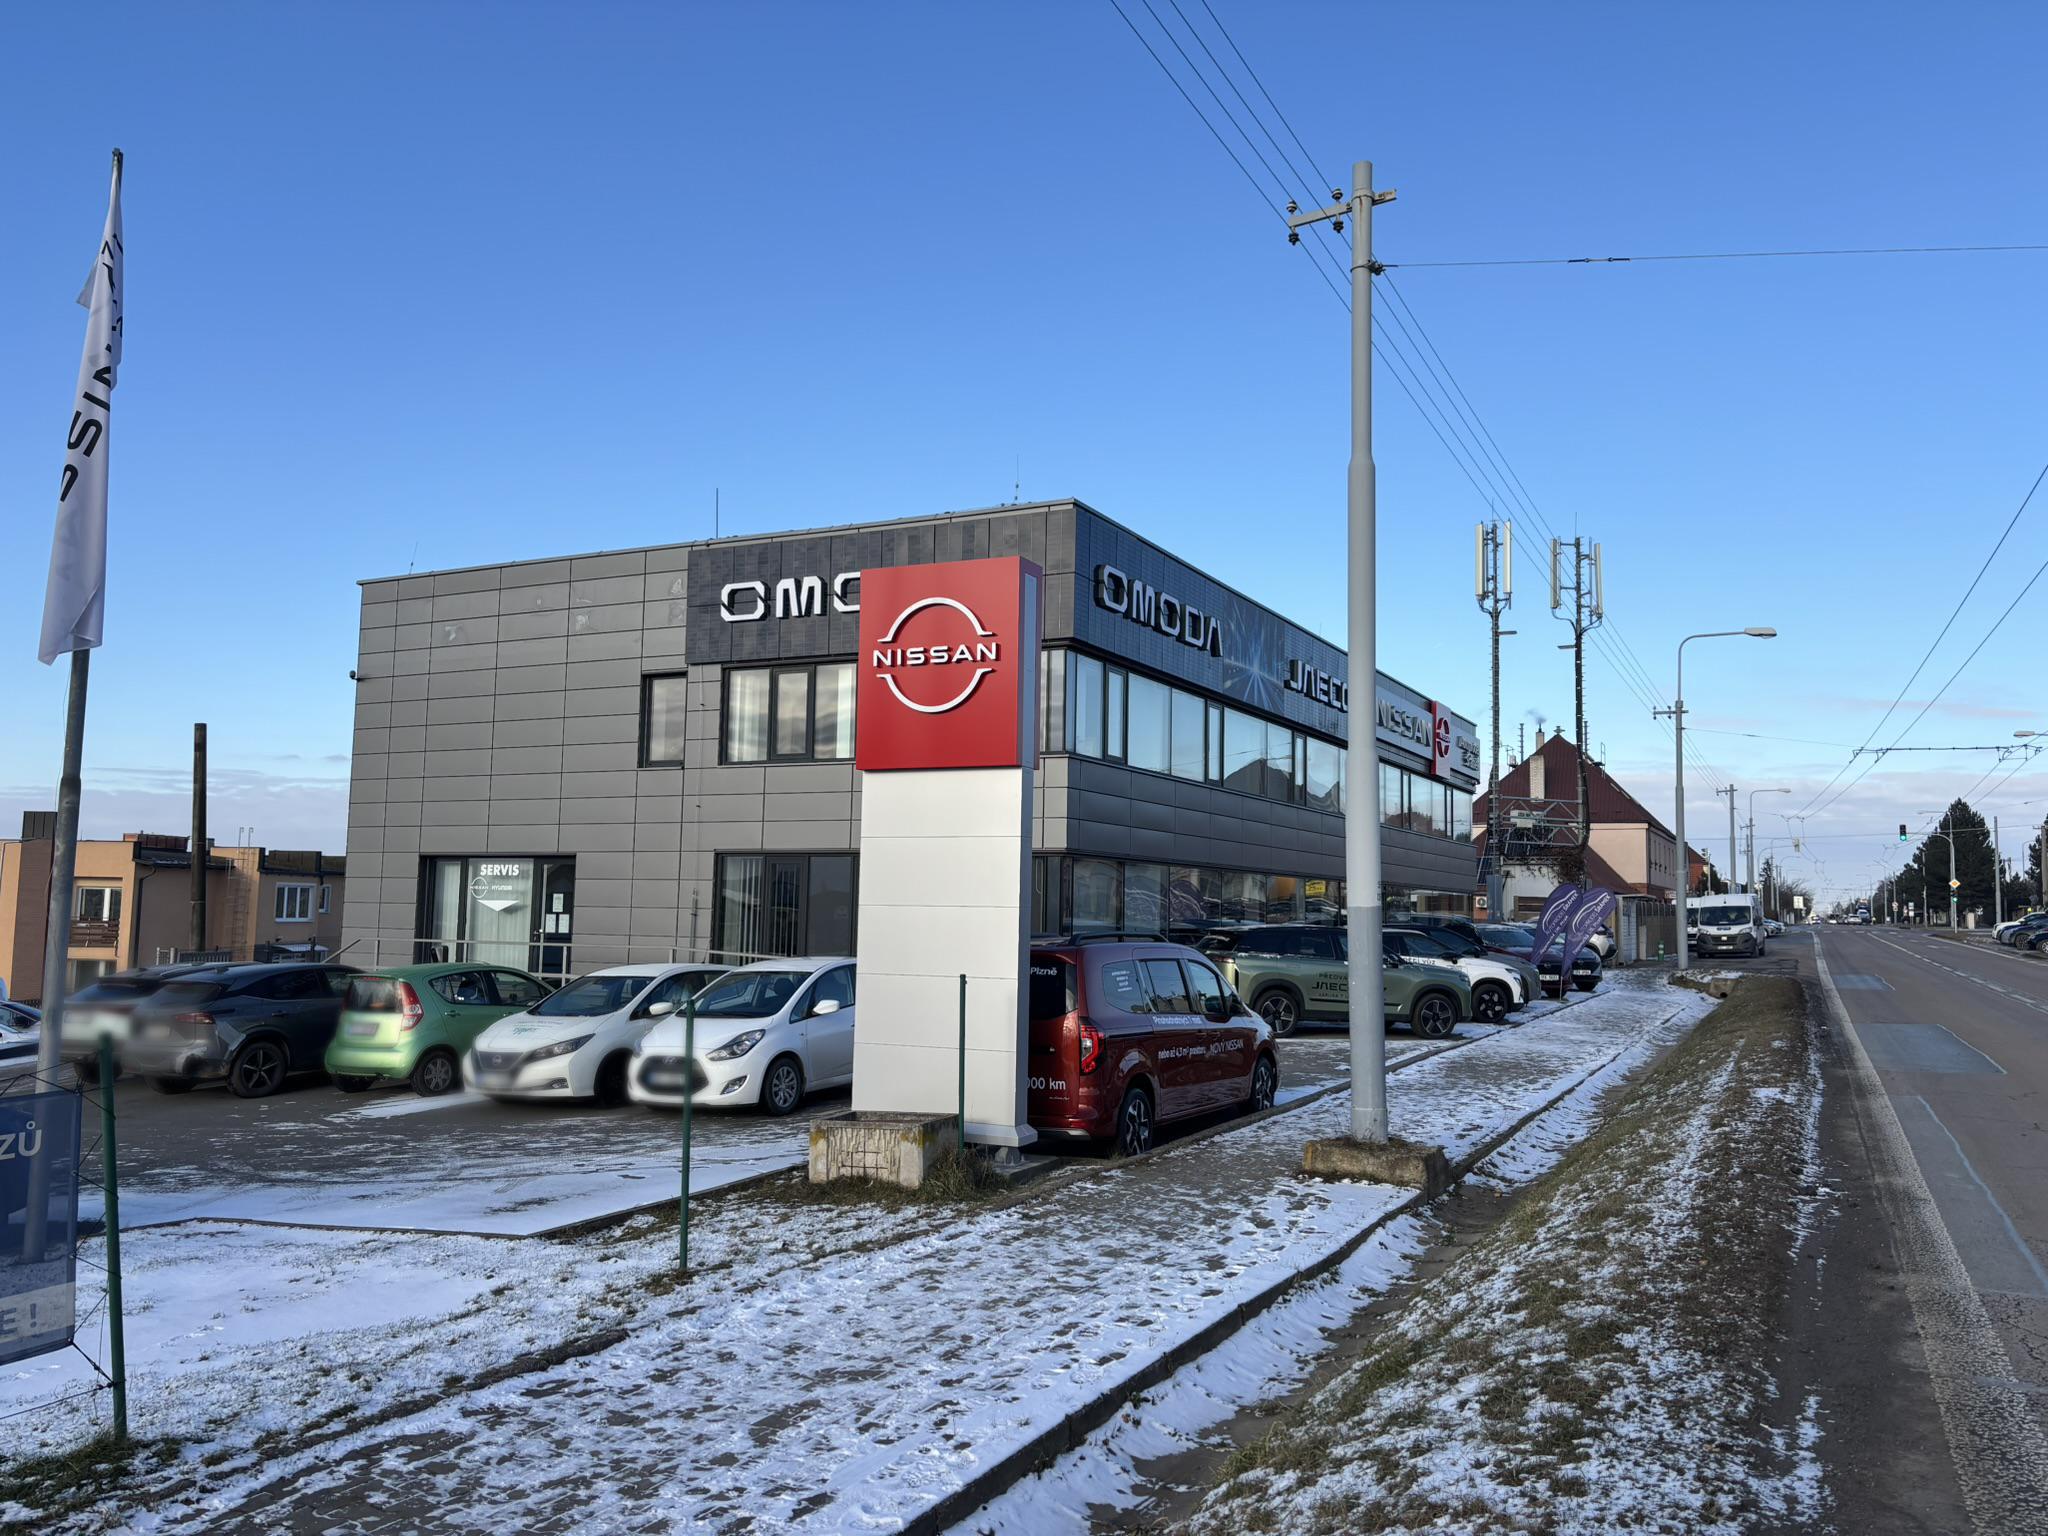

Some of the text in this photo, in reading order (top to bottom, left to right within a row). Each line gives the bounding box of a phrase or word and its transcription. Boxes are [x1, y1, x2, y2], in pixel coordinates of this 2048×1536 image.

[1097, 564, 1223, 657] OMODA
[873, 642, 998, 668] NISSAN
[1375, 696, 1432, 747] NISSAN
[480, 864, 520, 876] SERVIS
[1030, 966, 1058, 976] Plzně
[1049, 1076, 1066, 1090] km
